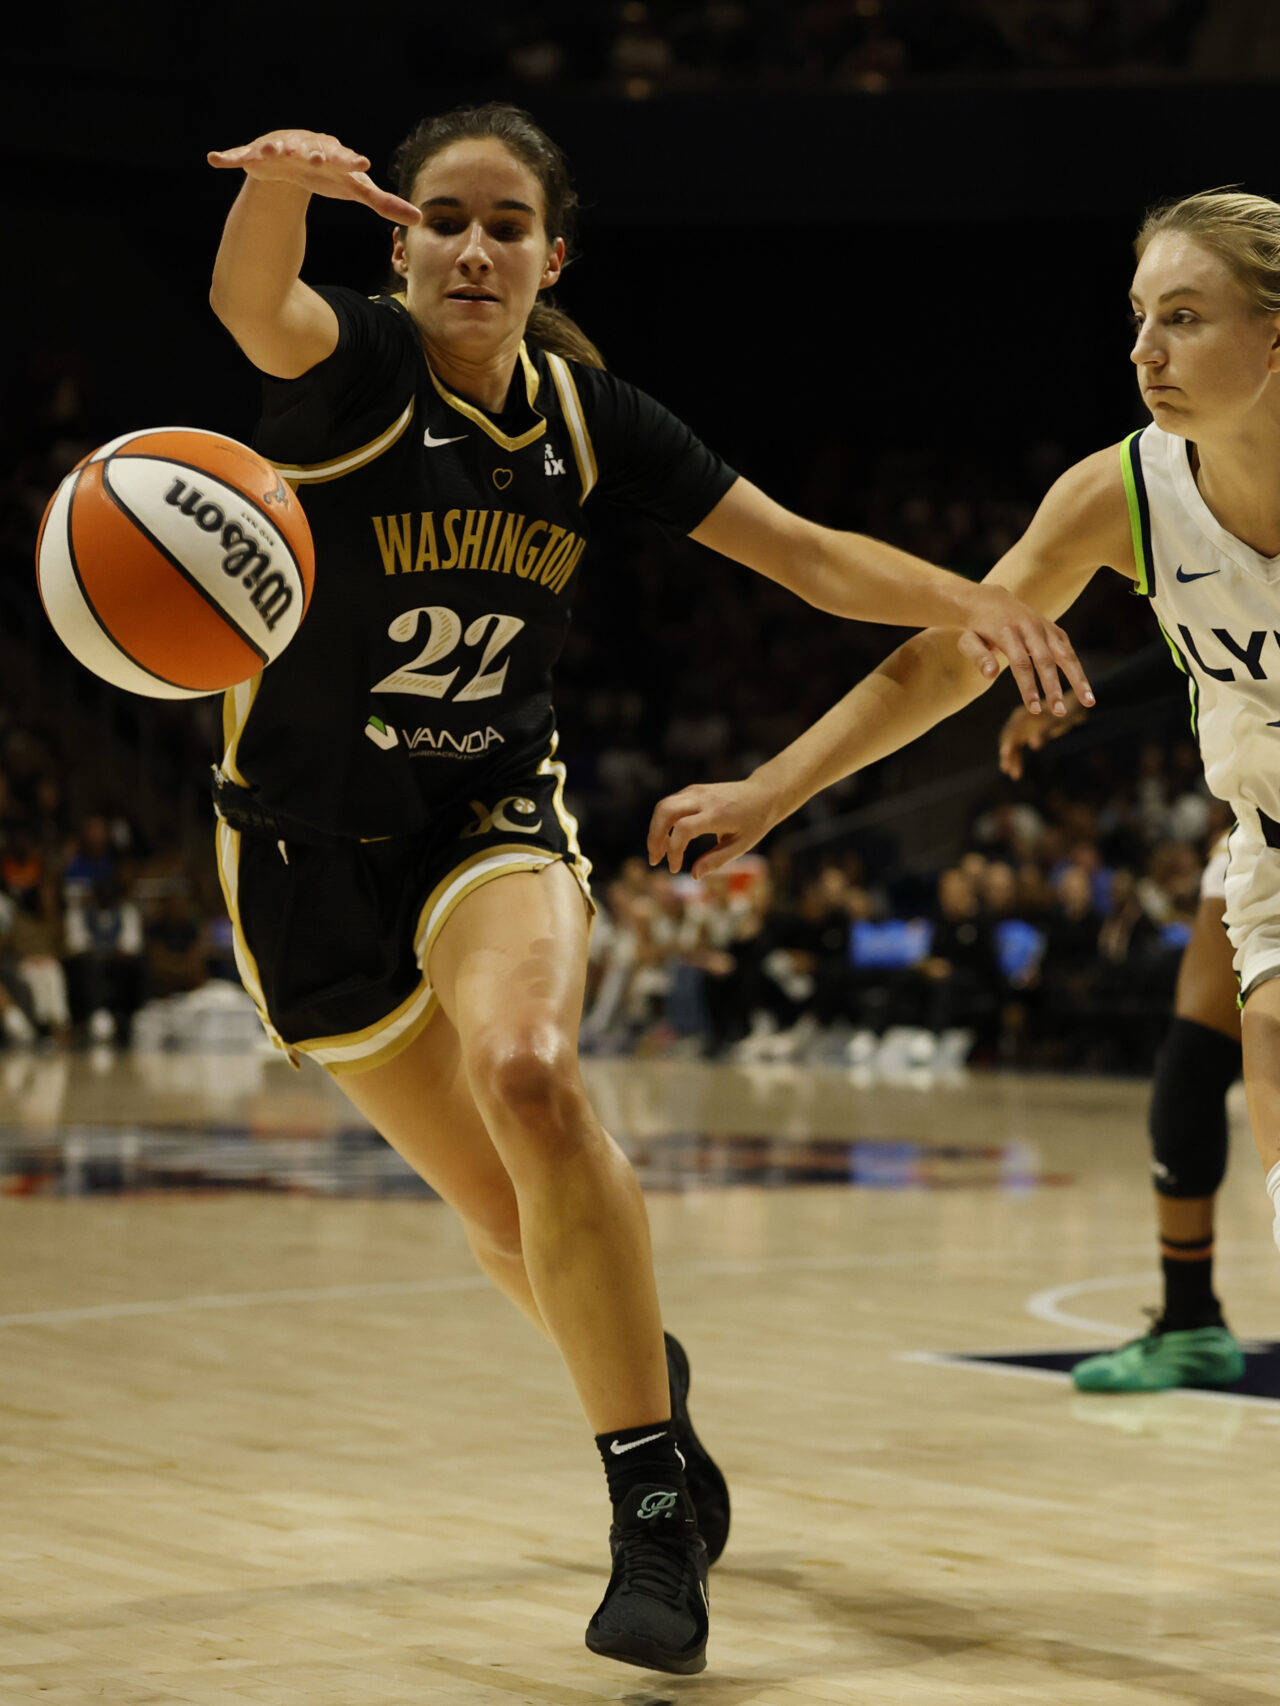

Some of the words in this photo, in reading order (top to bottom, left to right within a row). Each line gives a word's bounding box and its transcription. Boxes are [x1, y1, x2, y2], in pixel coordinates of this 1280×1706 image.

[164, 475, 292, 632] Wilson
[371, 508, 587, 595] WASHINGTON
[370, 606, 526, 702] 22
[402, 726, 505, 753] VANDA
